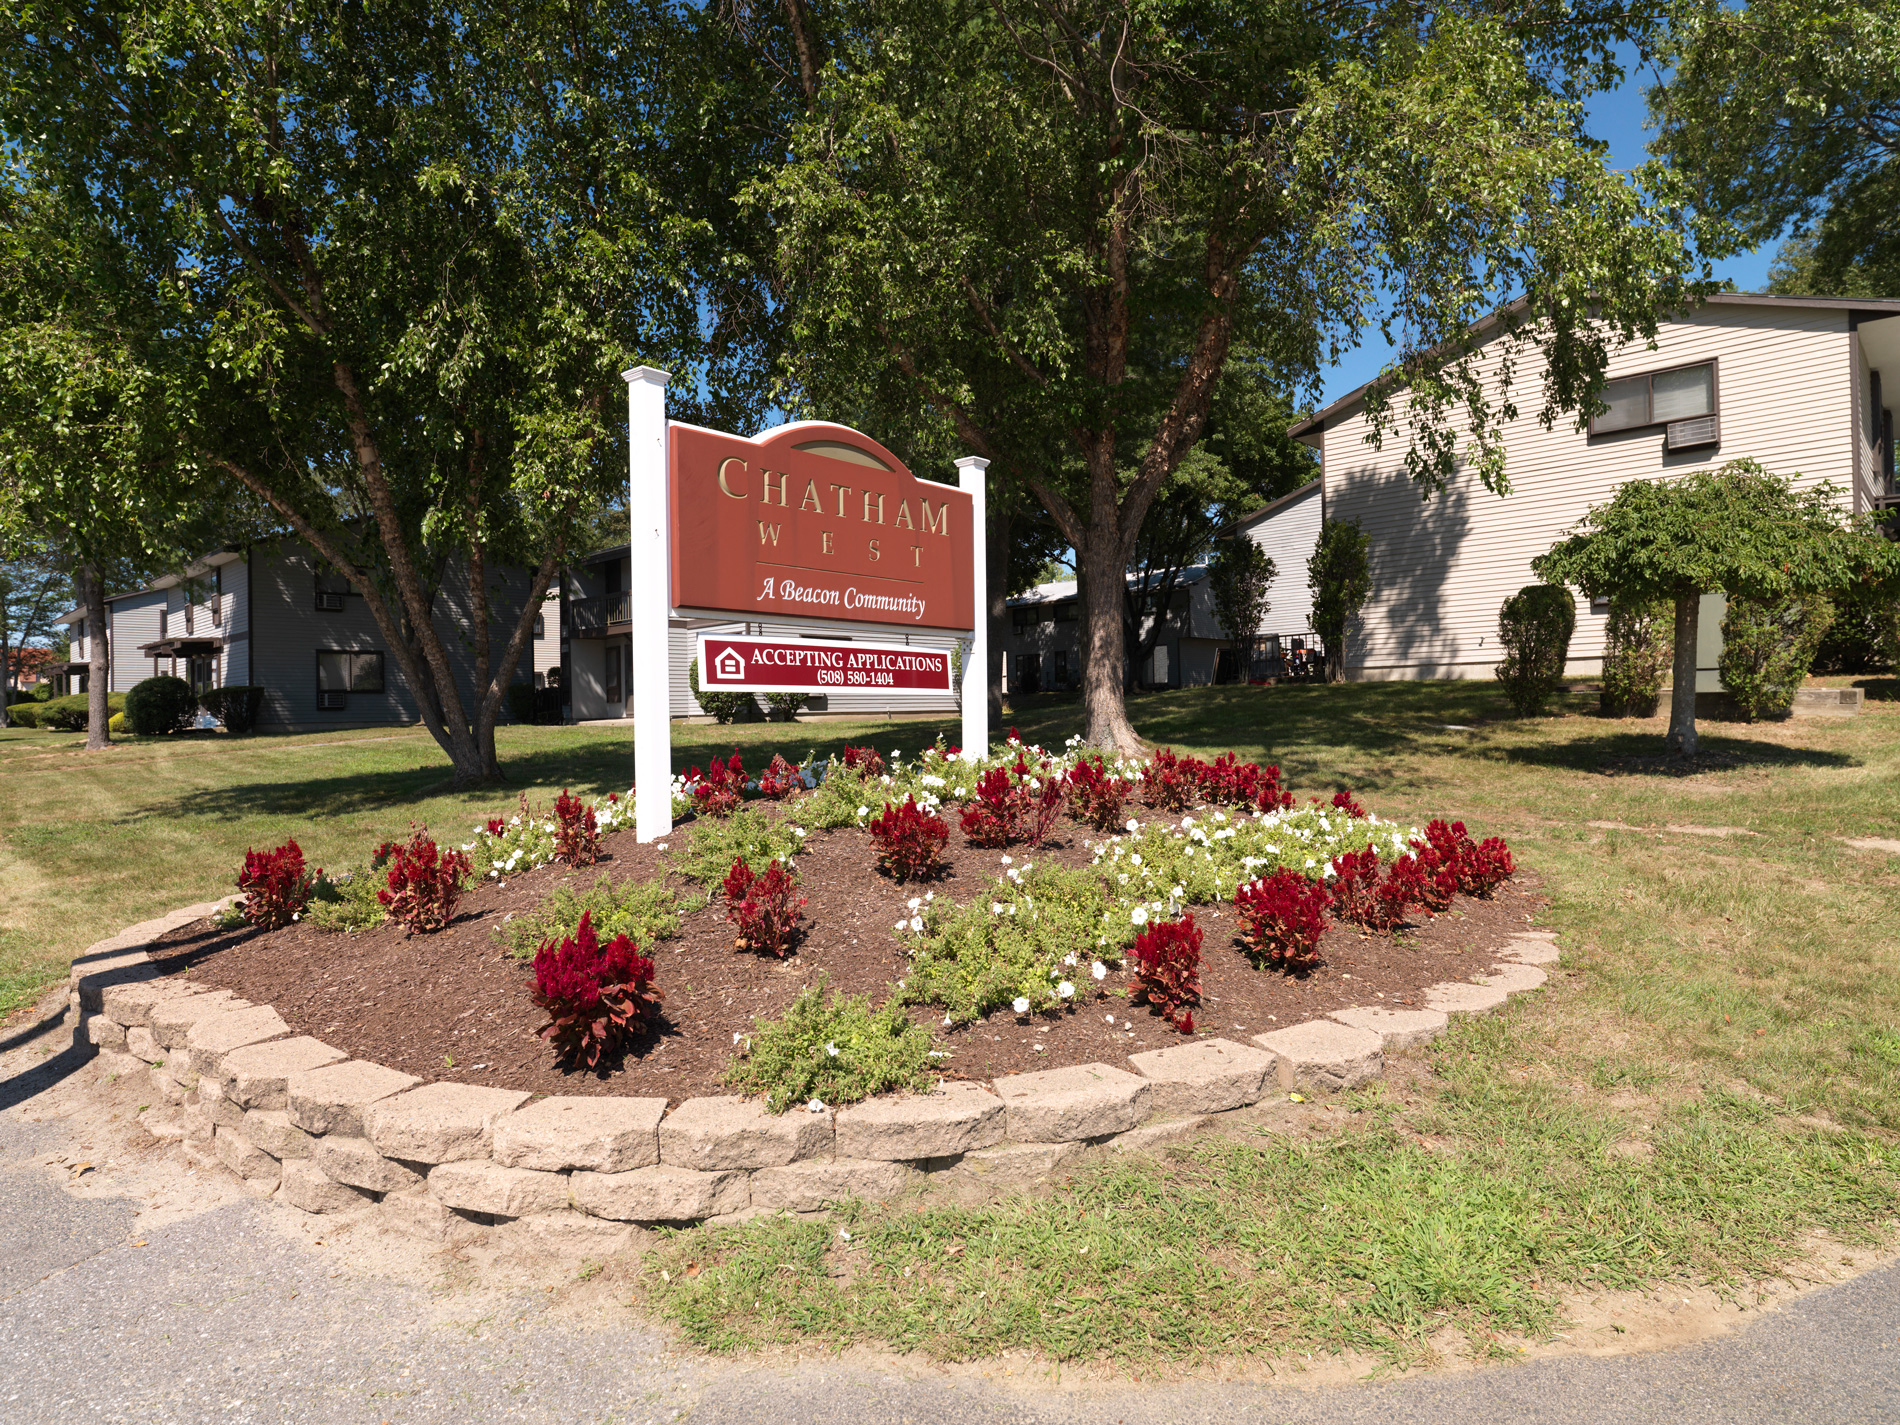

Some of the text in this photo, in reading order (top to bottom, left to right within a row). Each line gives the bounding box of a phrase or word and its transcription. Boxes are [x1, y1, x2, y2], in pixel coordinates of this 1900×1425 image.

[717, 456, 950, 536] CHATHAM
[756, 520, 924, 567] WEST
[756, 577, 926, 620] A Beacon Community
[751, 648, 943, 672] ACCEPTING APPLICATIONS
[817, 669, 894, 686] (508) 580-1404
